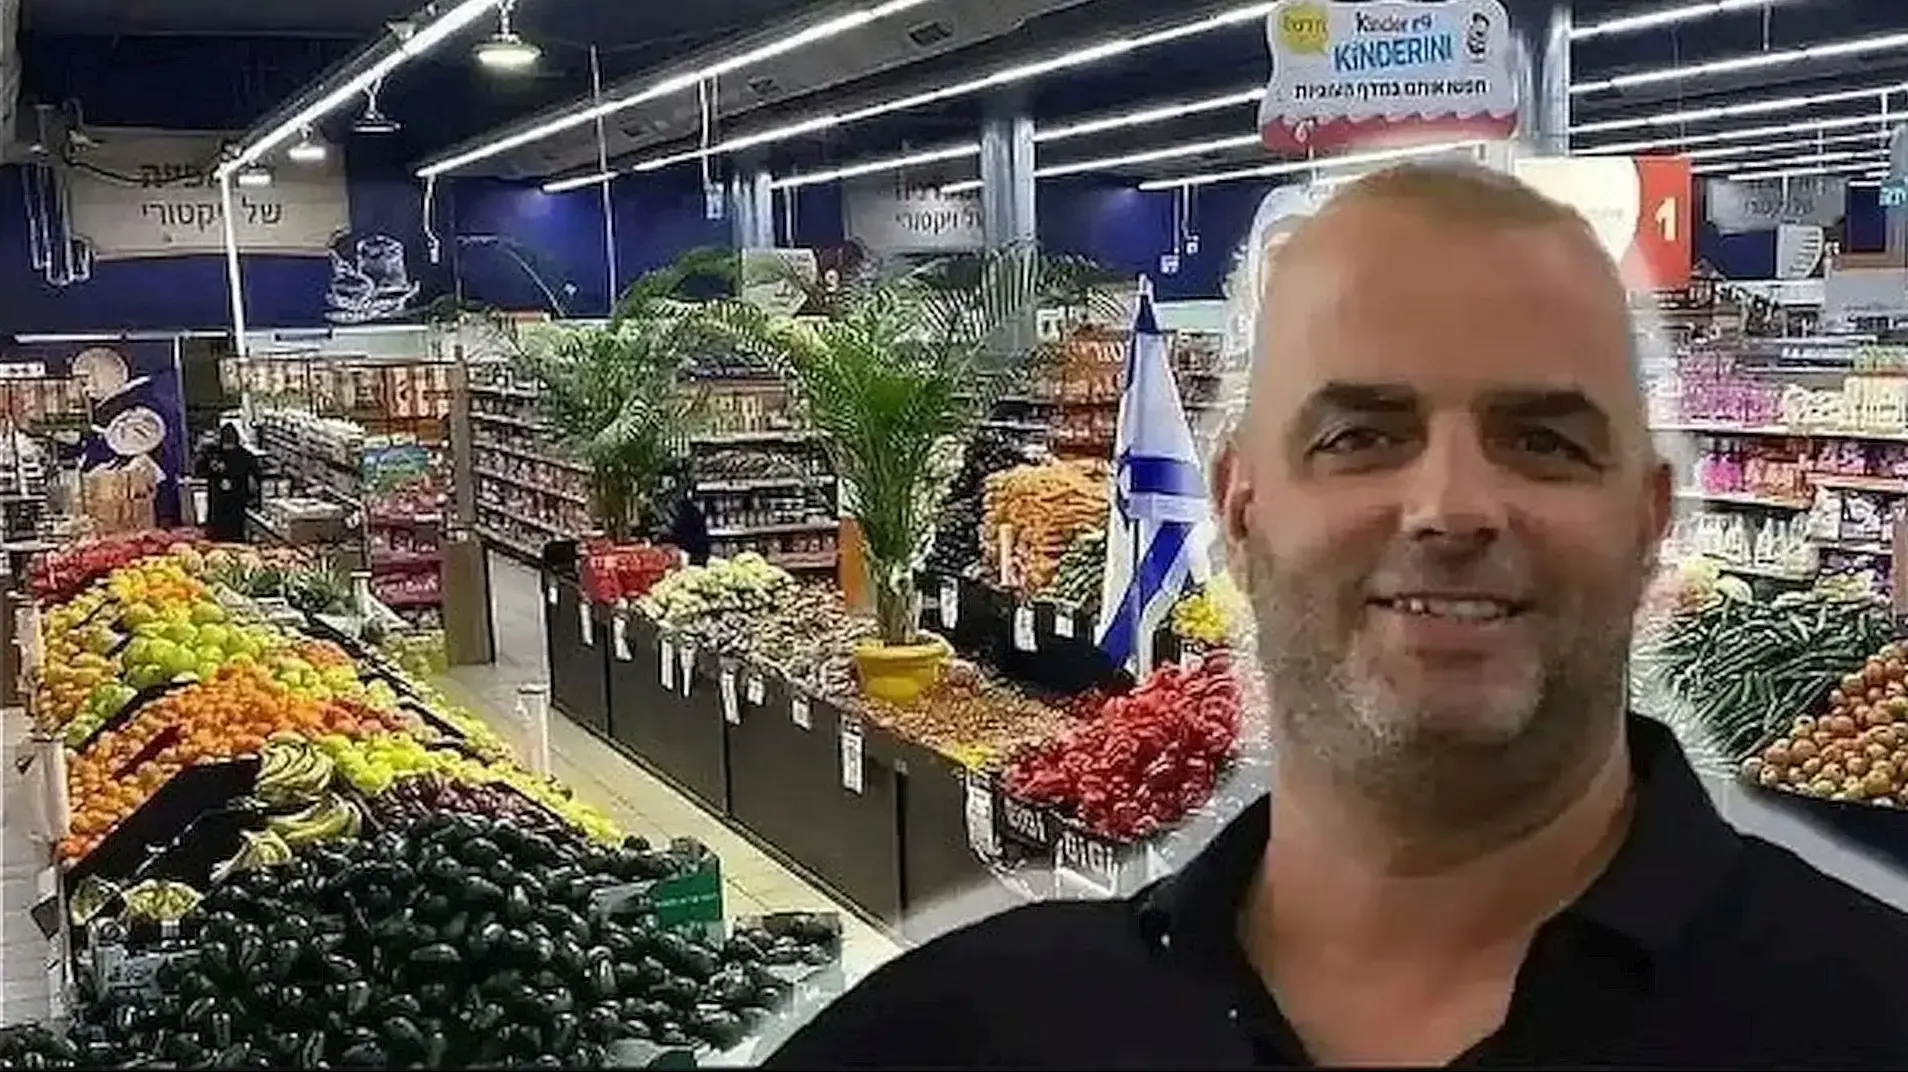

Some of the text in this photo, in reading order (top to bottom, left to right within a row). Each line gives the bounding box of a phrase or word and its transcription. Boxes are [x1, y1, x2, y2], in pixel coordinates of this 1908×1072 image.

[142, 195, 282, 232] של יקטורי
[1655, 196, 1677, 242] 1
